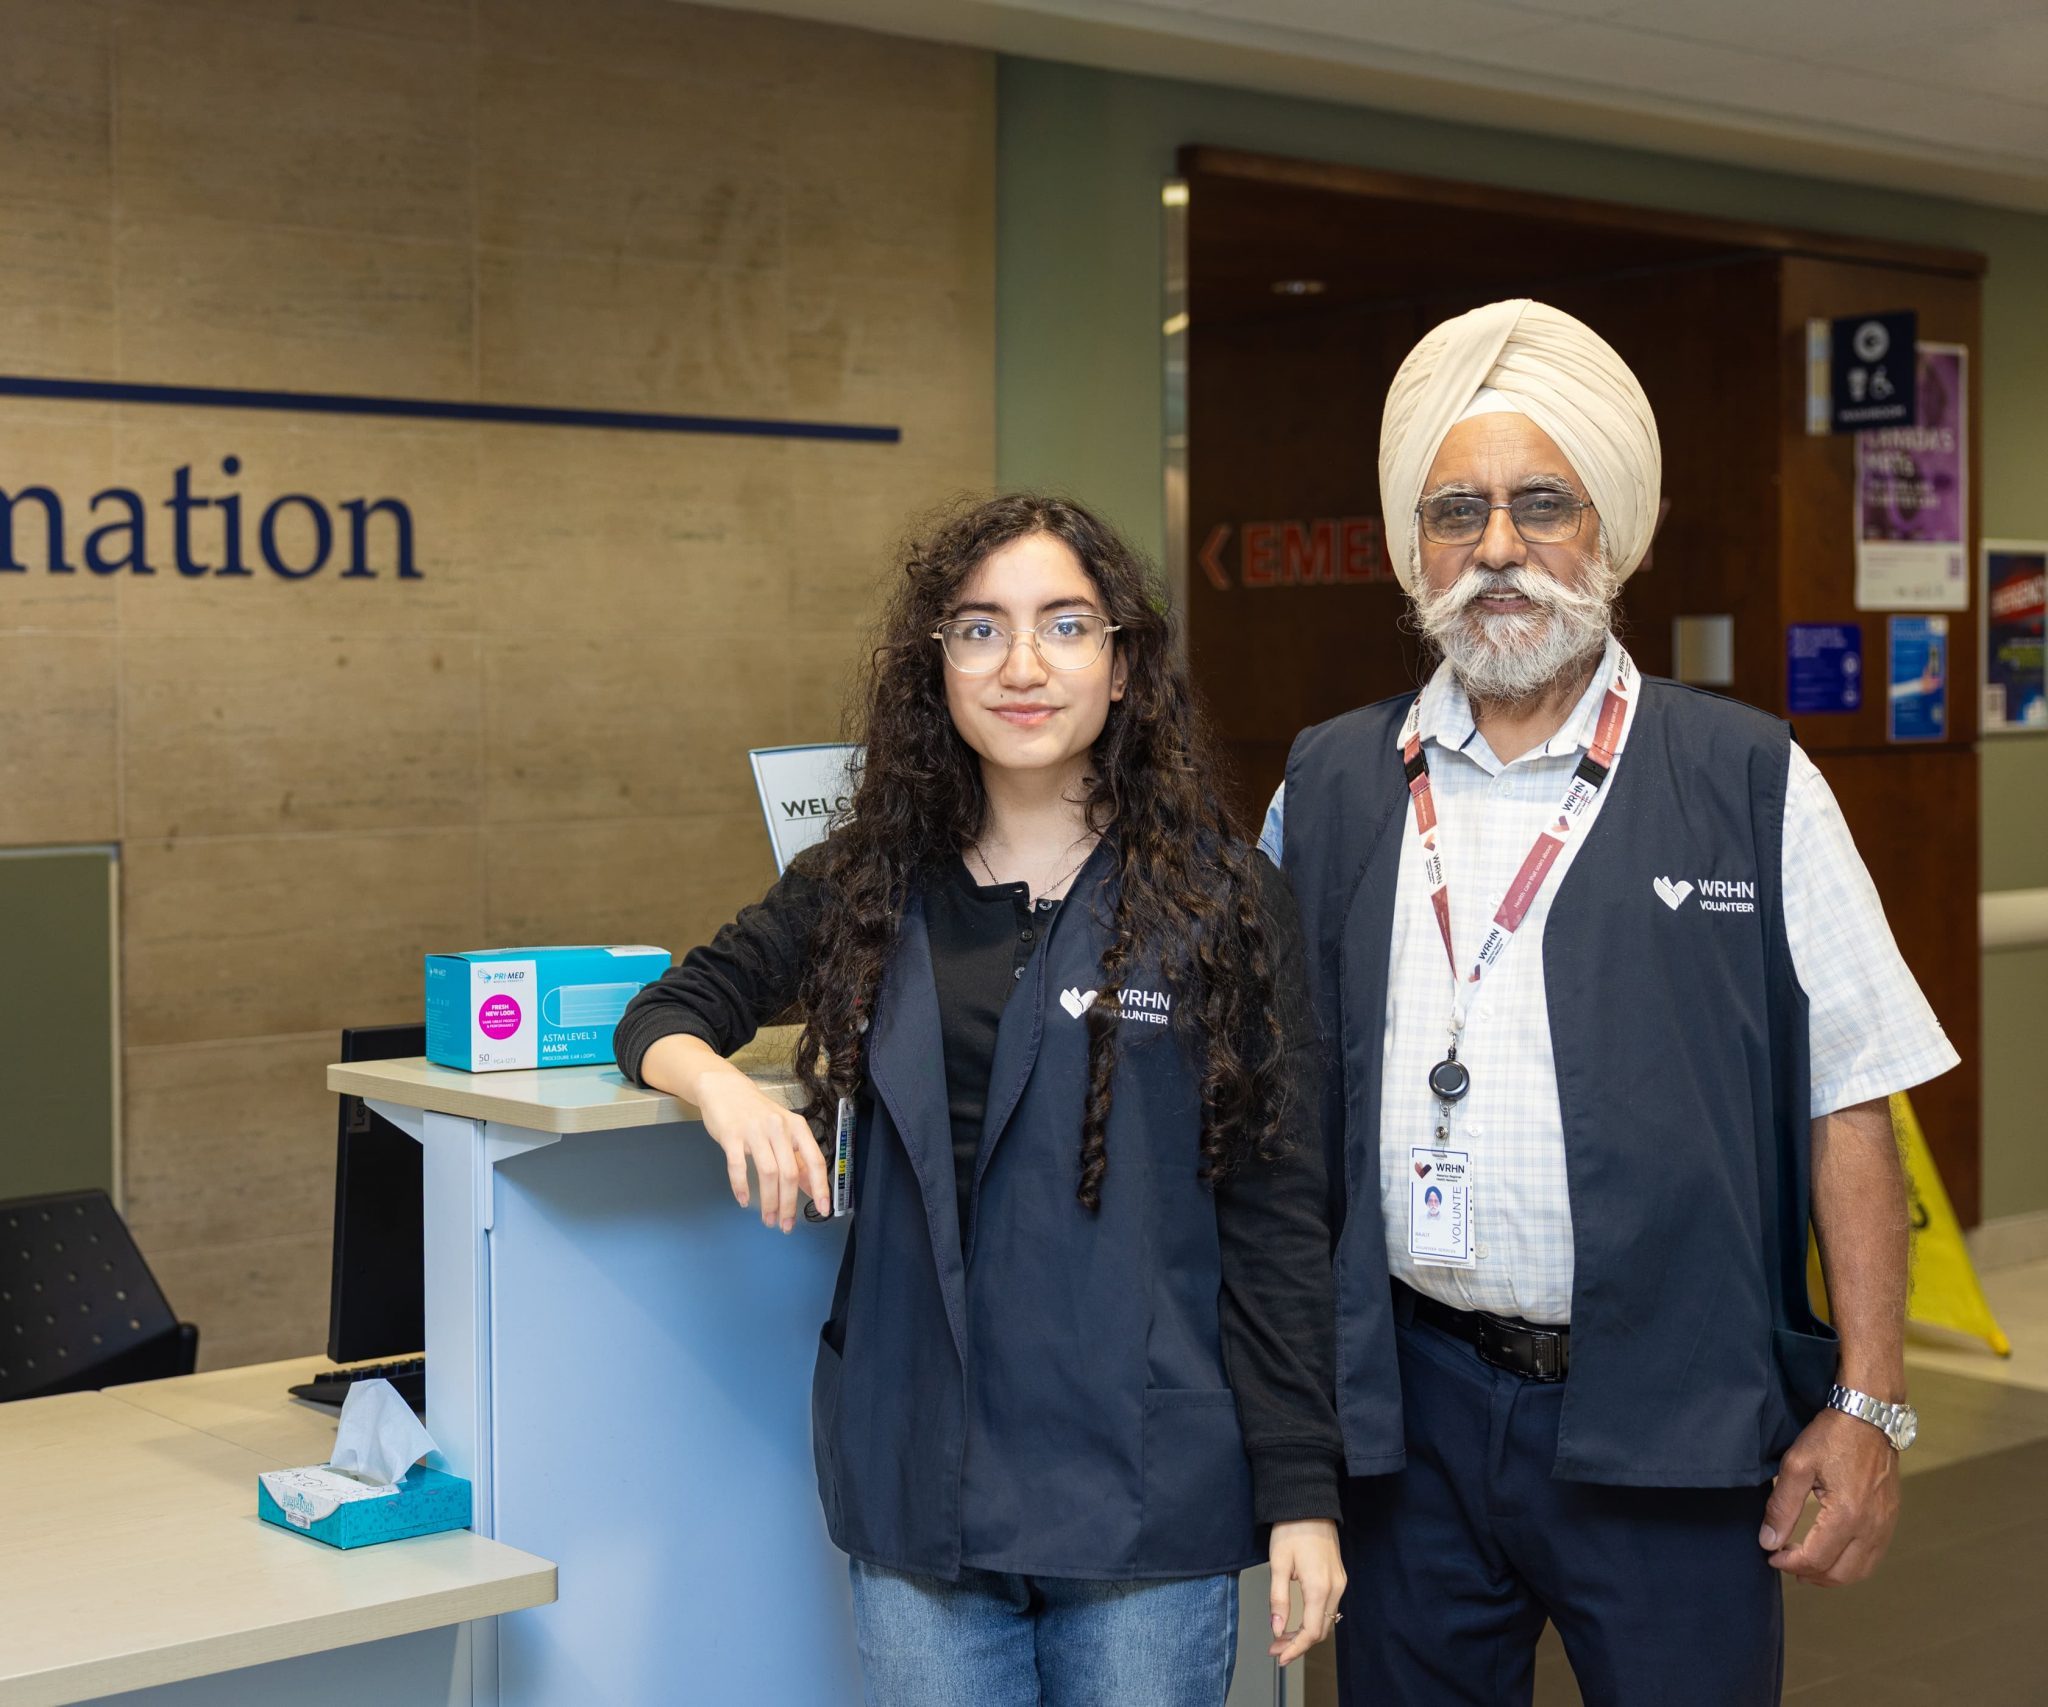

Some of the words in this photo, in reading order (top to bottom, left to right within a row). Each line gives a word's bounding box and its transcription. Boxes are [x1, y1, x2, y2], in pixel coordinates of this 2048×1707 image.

[1562, 781, 1585, 811] WRHN
[1433, 853, 1443, 885] WRHN
[1697, 878, 1754, 898] WRHN
[1699, 900, 1754, 912] VOLUNTEER
[1478, 928, 1500, 960] WRHN
[543, 1033, 566, 1042] ASTM
[567, 1032, 591, 1041] LEVEL
[592, 1031, 597, 1040] 3
[543, 1044, 568, 1053] MASK
[479, 1053, 490, 1062] 50
[1436, 1163, 1465, 1173] WRHN
